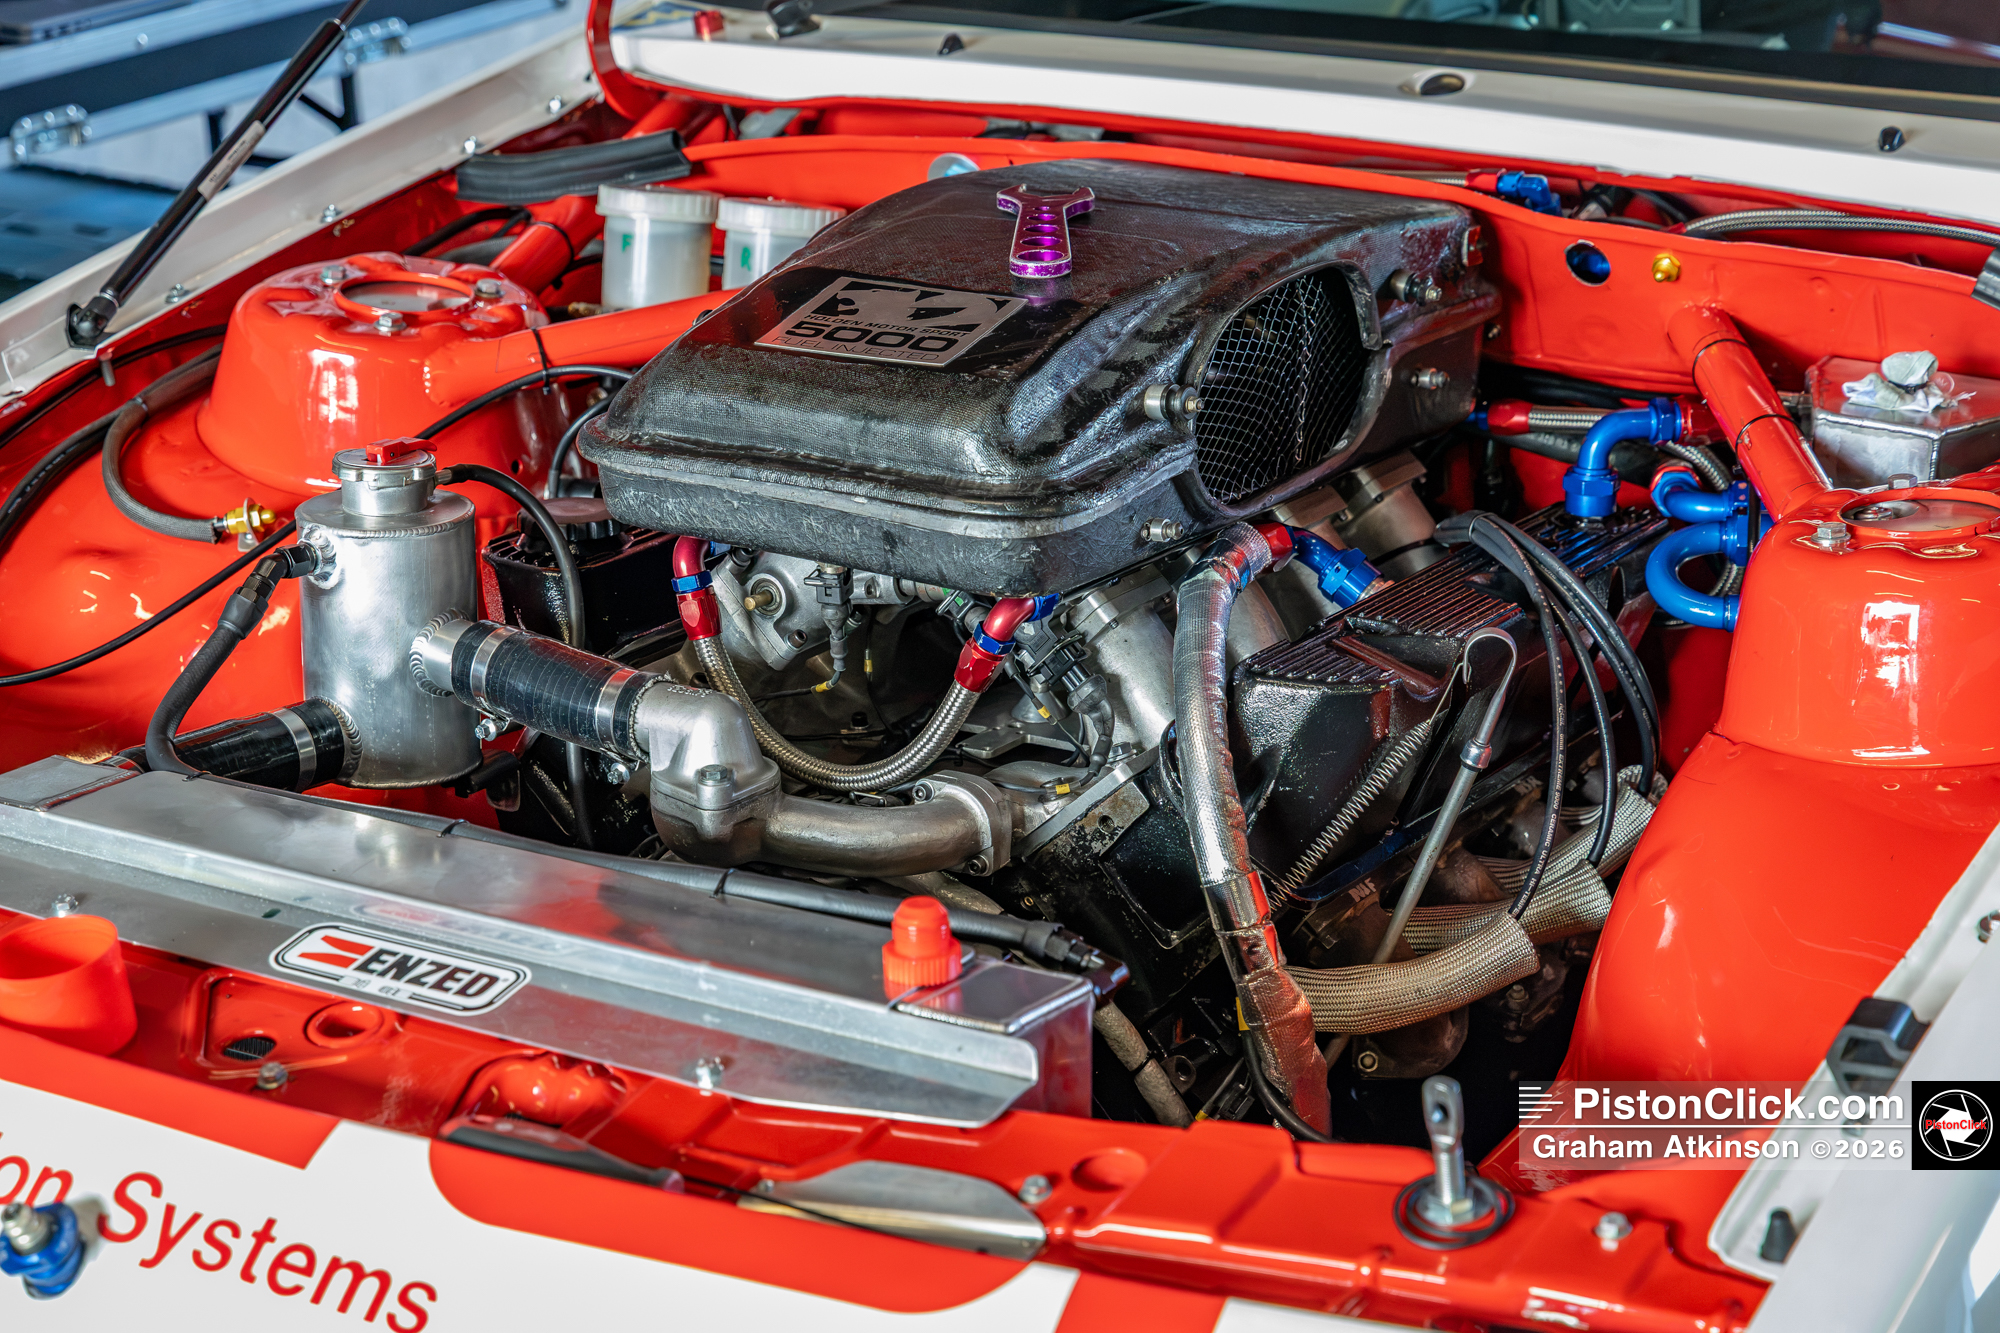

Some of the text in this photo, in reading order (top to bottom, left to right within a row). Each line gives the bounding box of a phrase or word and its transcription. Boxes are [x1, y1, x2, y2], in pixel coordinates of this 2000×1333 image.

[621, 234, 634, 253] F
[740, 247, 751, 272] R
[785, 320, 960, 352] 5000
[803, 314, 970, 339] HOLDEN MOTOR SPORT
[771, 336, 941, 361] FUEL INJECTED
[1556, 754, 1565, 791] EXTREME
[1544, 813, 1557, 848] CERAMIC
[1534, 850, 1549, 875] ULTRA
[353, 947, 500, 998] ENZED
[97, 1171, 438, 1333] Systems
